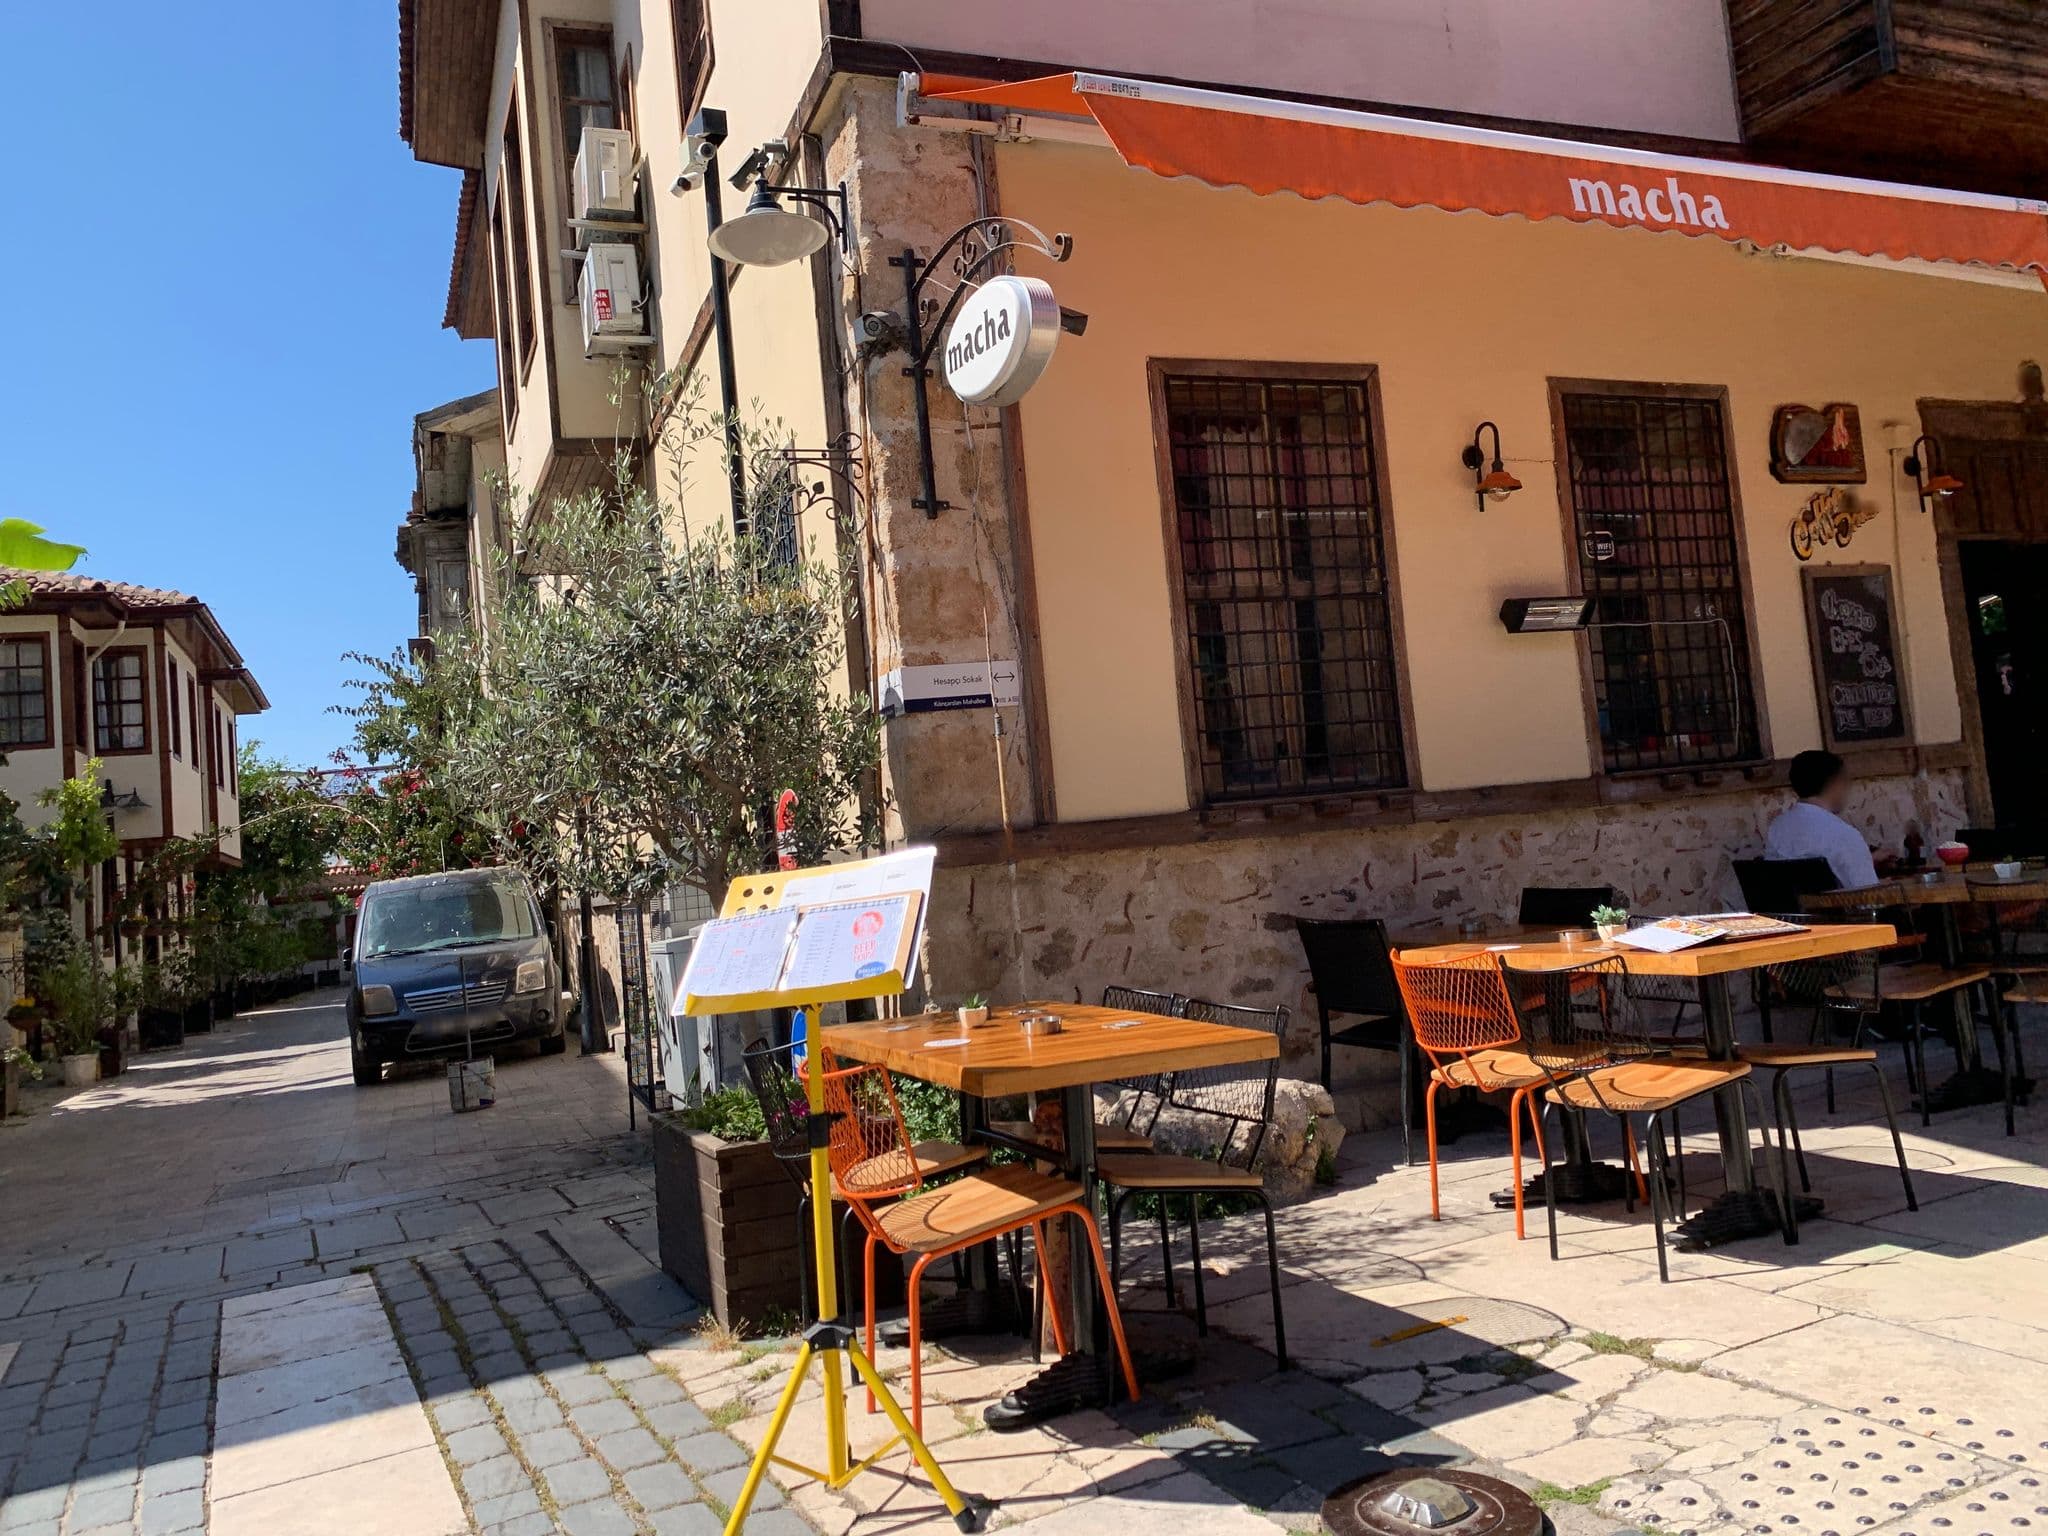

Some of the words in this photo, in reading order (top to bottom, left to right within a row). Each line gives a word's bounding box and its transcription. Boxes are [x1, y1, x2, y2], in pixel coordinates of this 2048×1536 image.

[1568, 177, 1730, 230] macha
[947, 308, 1011, 375] macha
[962, 675, 983, 684] Sokak
